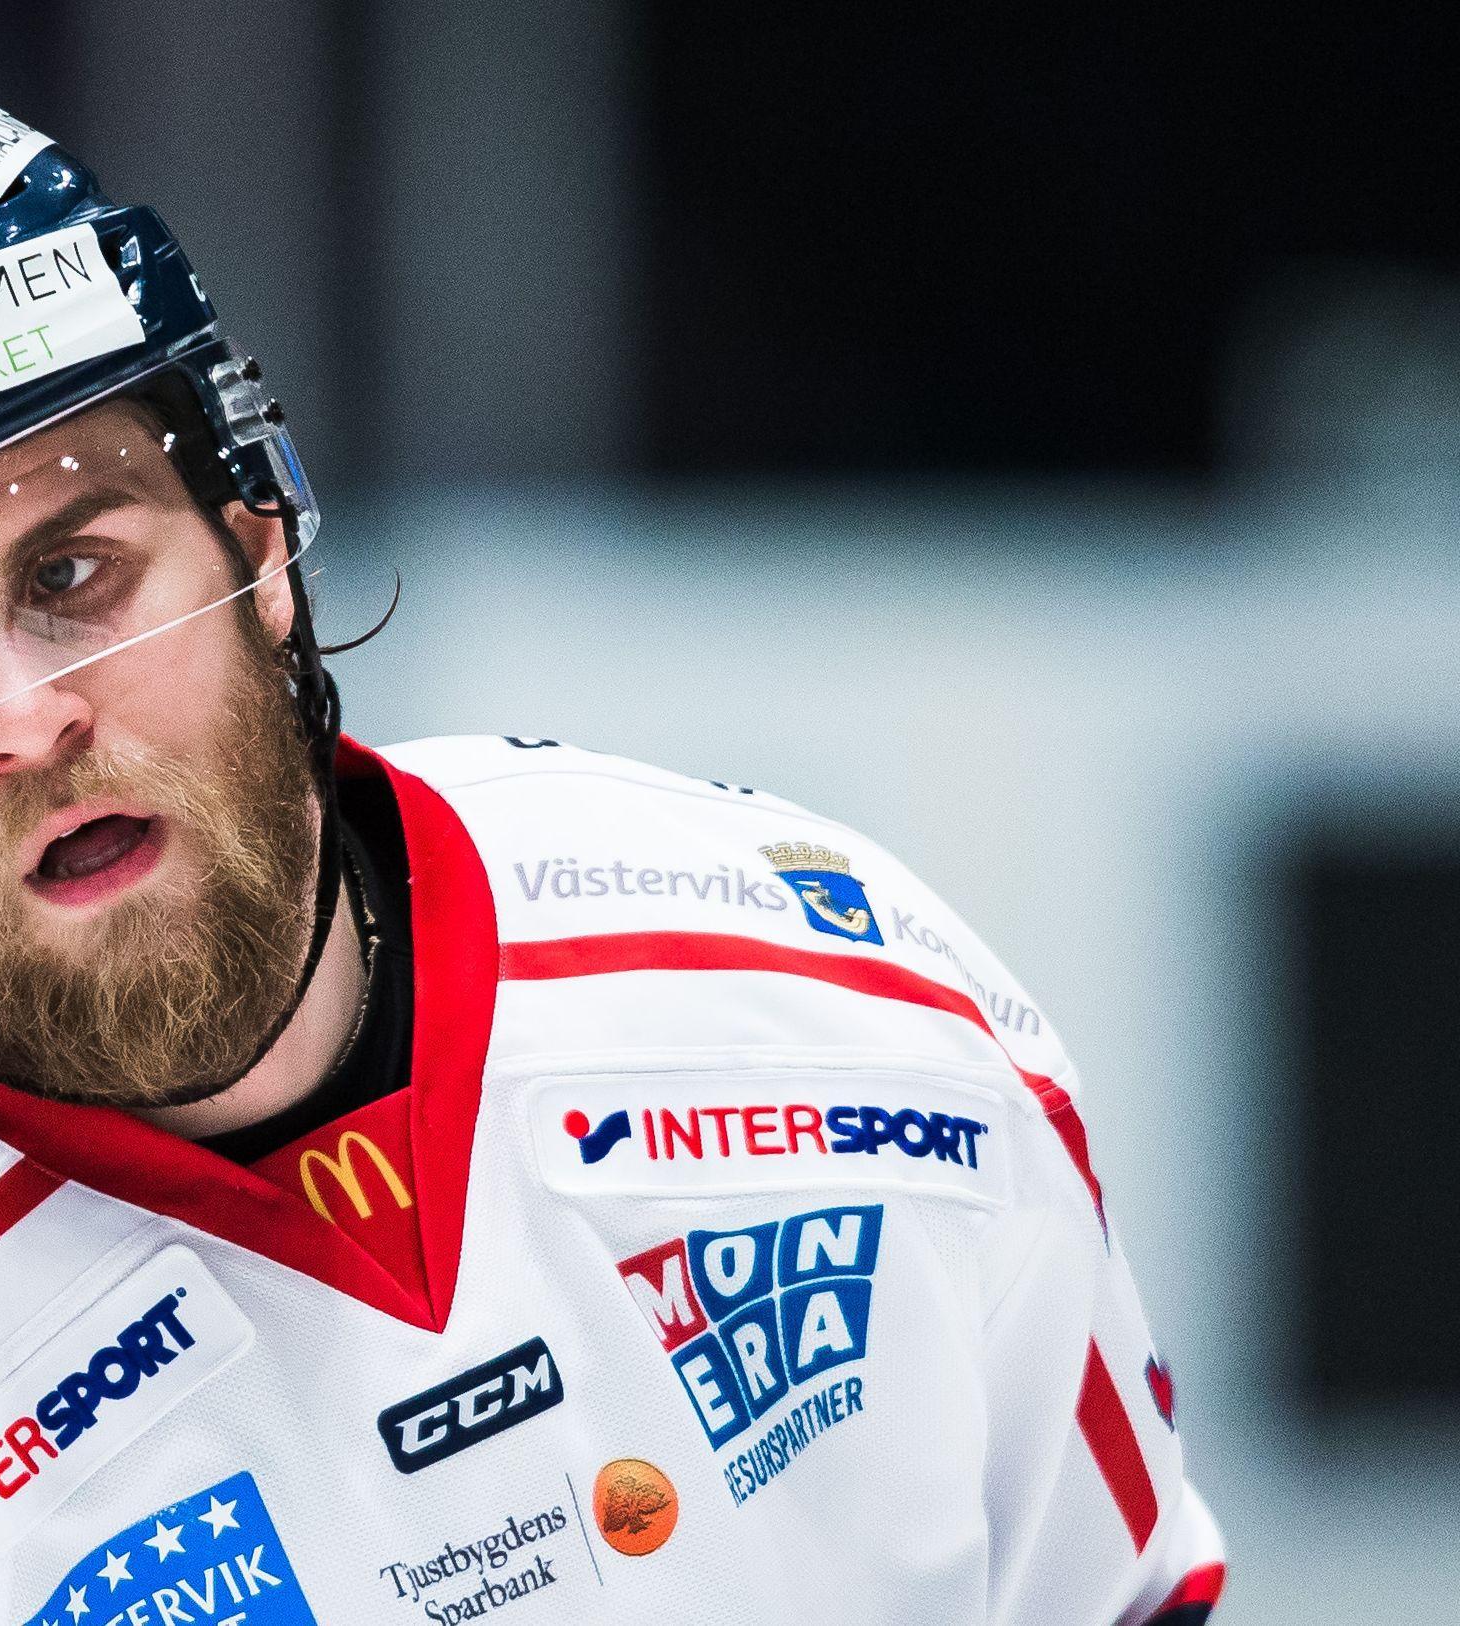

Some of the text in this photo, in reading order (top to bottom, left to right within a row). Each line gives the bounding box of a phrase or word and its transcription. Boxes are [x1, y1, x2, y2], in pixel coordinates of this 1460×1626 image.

[513, 858, 788, 911] Västerviks
[642, 1104, 987, 1170] INTERSPORT
[394, 1354, 555, 1457] CCM
[723, 1376, 865, 1508] RESURSPARTNER
[379, 1505, 568, 1603] Tjustbygdens
